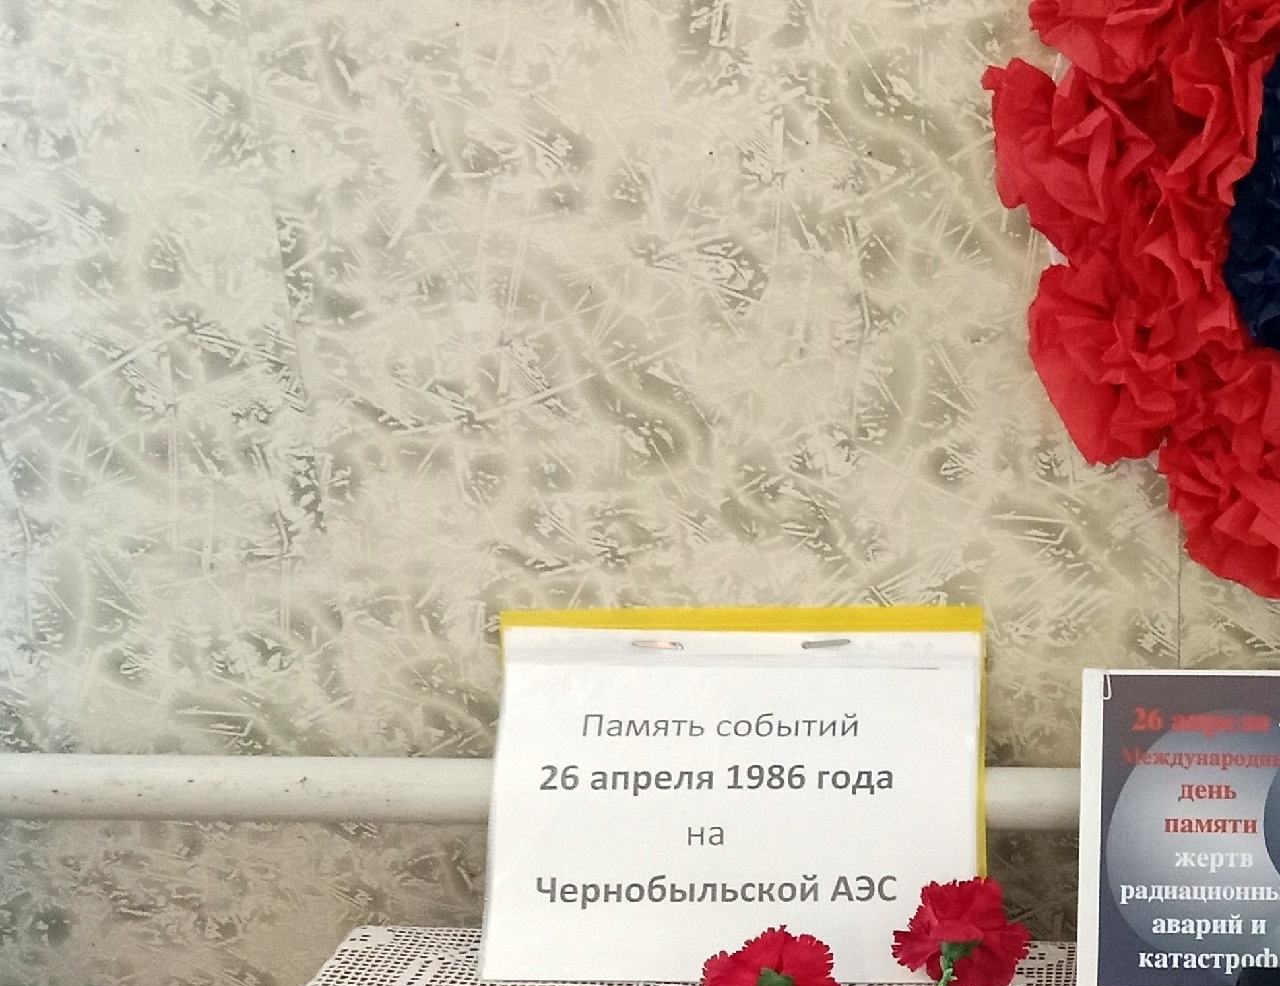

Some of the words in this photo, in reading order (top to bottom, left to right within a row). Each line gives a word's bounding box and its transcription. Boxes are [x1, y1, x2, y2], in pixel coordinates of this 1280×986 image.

[582, 714, 704, 737] Память
[716, 713, 859, 737] событий
[1132, 707, 1163, 731] 26
[539, 764, 579, 790] 26
[590, 768, 713, 796] апреля
[727, 764, 805, 790] 1986
[817, 768, 893, 795] года
[1178, 783, 1237, 801] день
[687, 826, 725, 846] на
[1164, 817, 1257, 835] памяти
[1175, 852, 1253, 873] жертв
[536, 875, 819, 908] Чернобыльской
[831, 876, 897, 902] АЭС
[1152, 914, 1242, 939] аварий
[1251, 919, 1266, 934] и
[1139, 948, 1278, 975] катастроф
